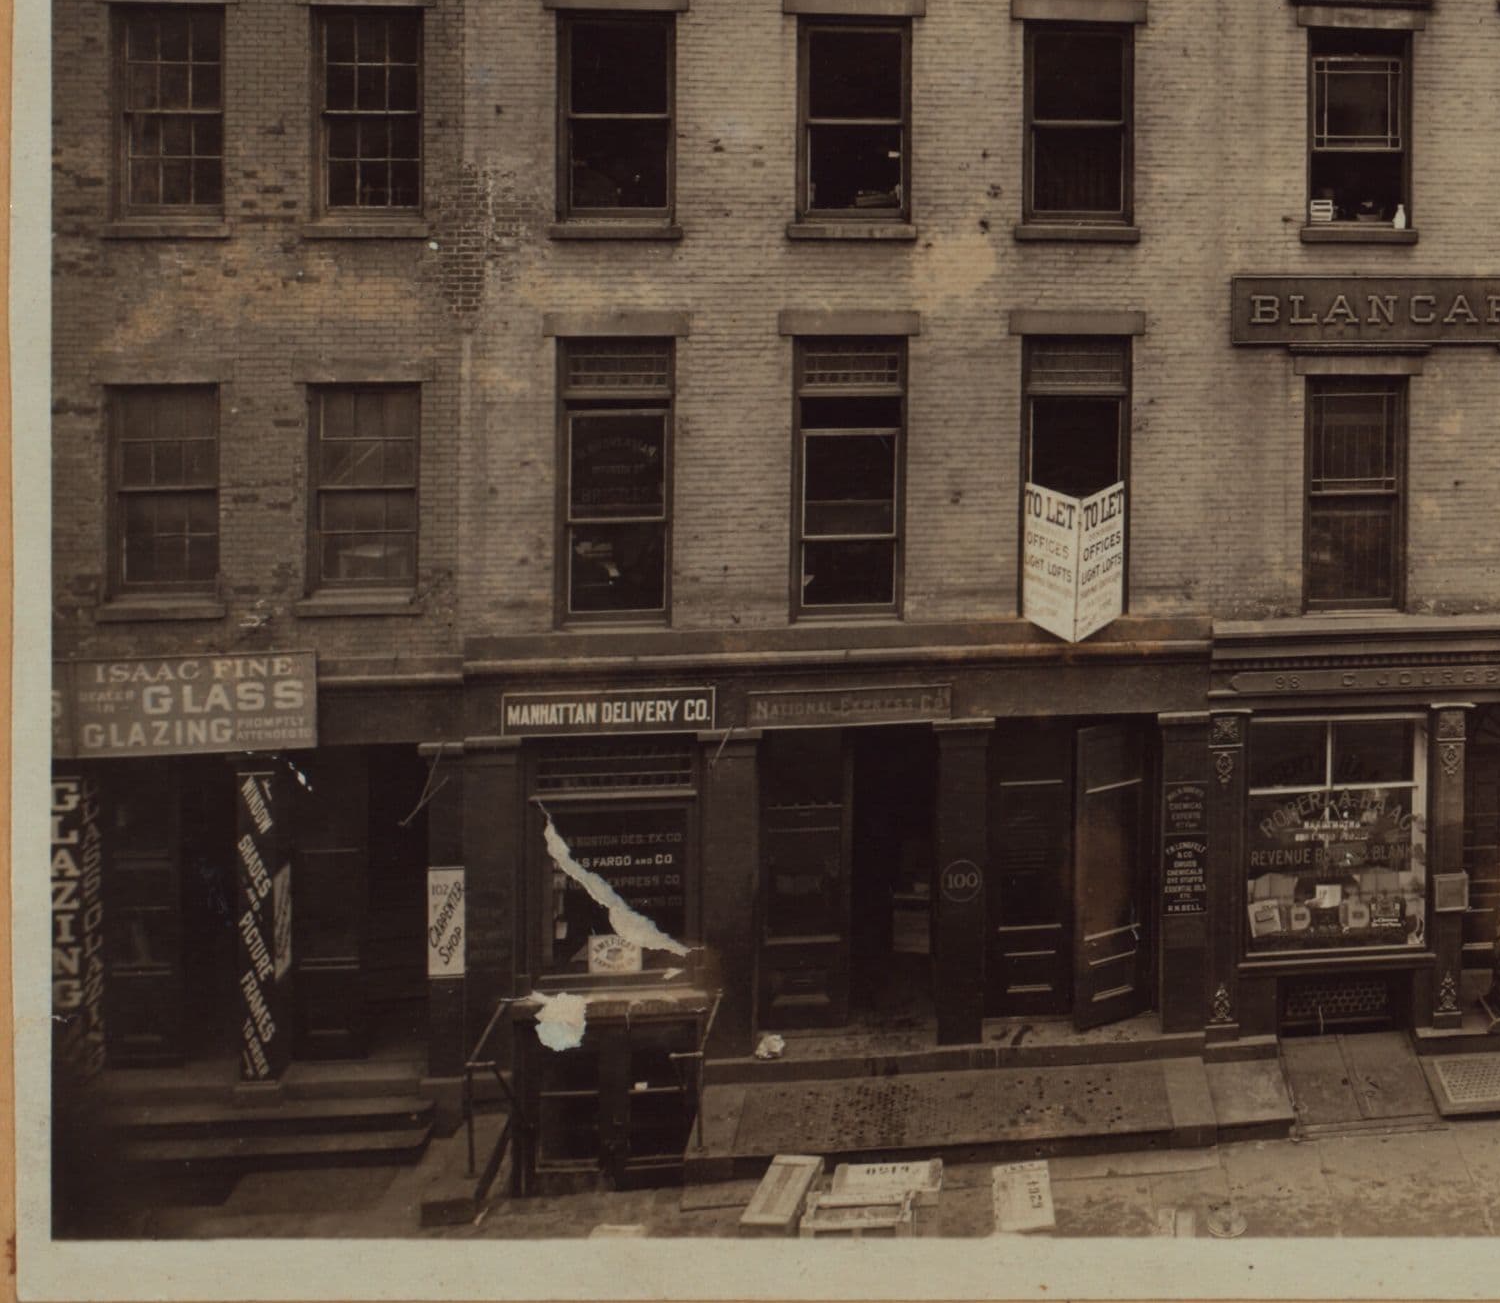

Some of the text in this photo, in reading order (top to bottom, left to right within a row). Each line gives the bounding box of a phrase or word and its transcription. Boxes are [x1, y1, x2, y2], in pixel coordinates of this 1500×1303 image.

[1025, 488, 1076, 530] TO LET
[1083, 488, 1124, 532] TO LET
[1026, 530, 1069, 560] OFFICES
[1083, 530, 1121, 562] OFFICES
[1047, 561, 1073, 584] LOFTS
[1081, 551, 1122, 586] LIGHT LOFTS
[95, 657, 293, 683] ISAAC FINE
[142, 679, 305, 715] GLASS
[507, 698, 711, 727] MANHATTAN DELIVERY CO.
[82, 718, 233, 749] GLAZING
[242, 775, 273, 834] WINDOW
[238, 834, 272, 898] SHADES
[593, 855, 631, 868] FARGO
[1250, 847, 1311, 867] REVENUE
[947, 872, 978, 889] 100
[430, 881, 463, 965] CARPENTER SHOP
[238, 909, 274, 982] PICTURE
[240, 970, 276, 1043] FRAMES
